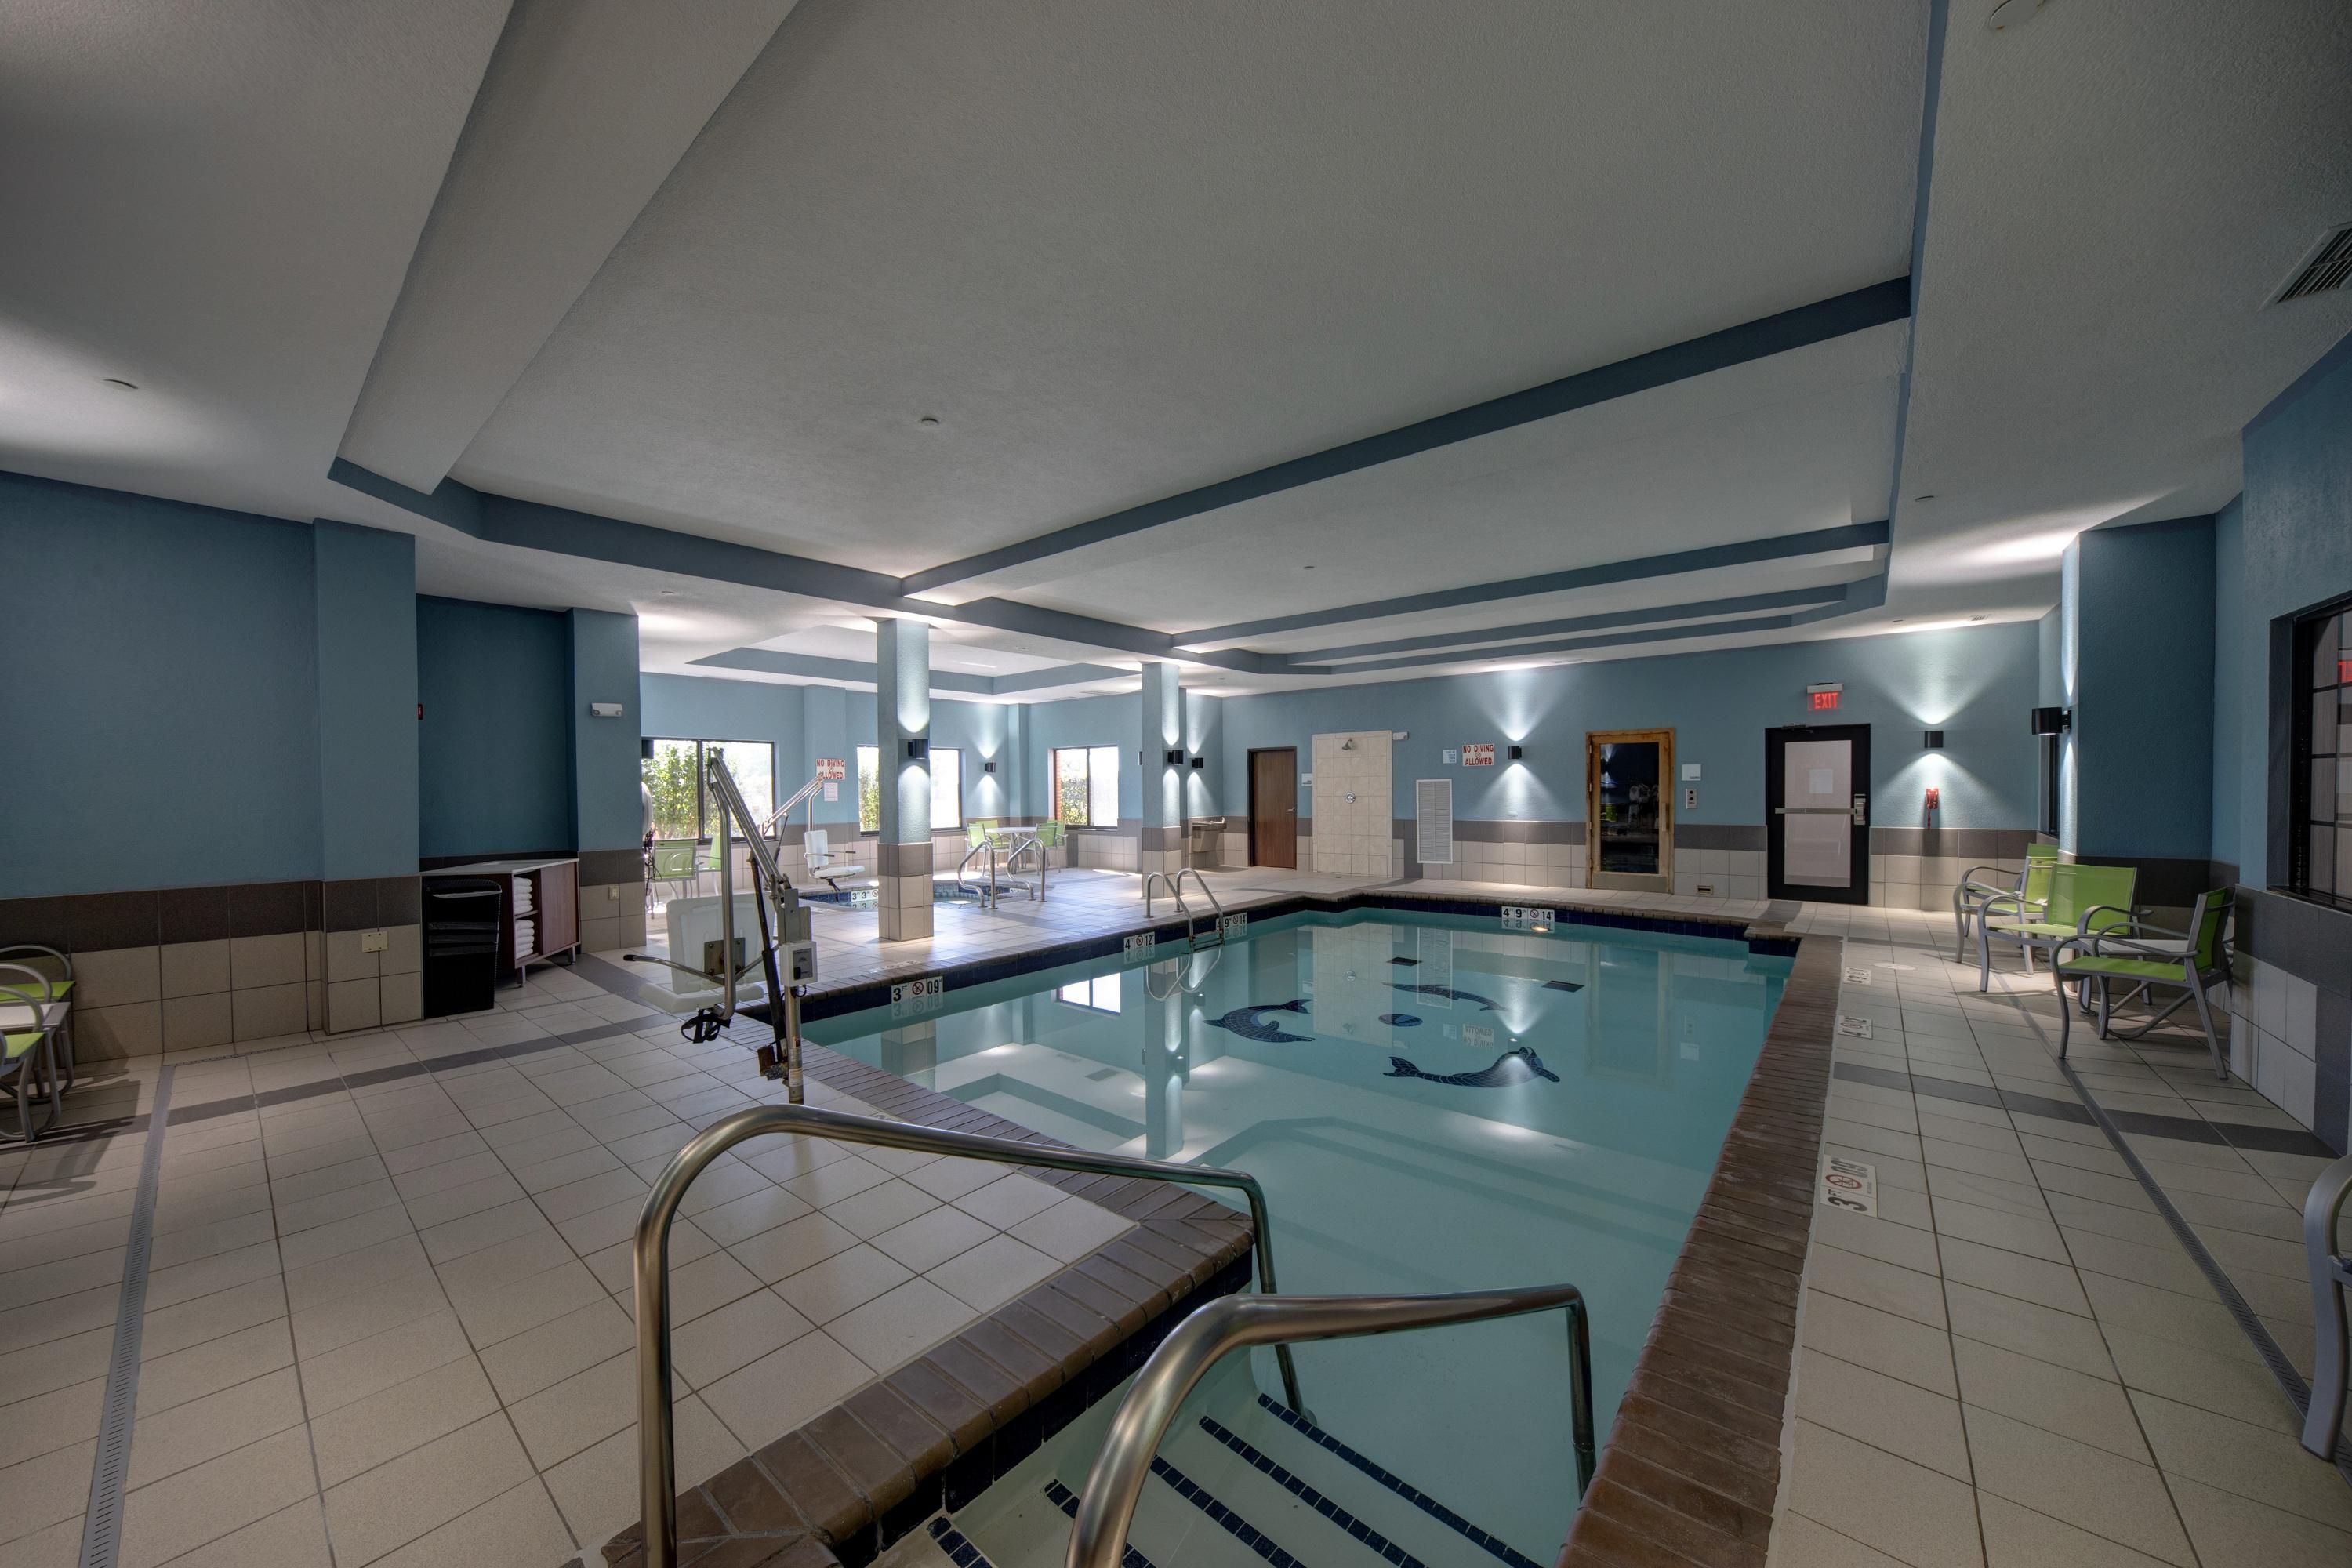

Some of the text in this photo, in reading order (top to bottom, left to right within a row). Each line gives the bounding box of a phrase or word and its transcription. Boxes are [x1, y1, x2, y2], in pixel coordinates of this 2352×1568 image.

[1814, 692, 1838, 709] EXIT
[1503, 908, 1510, 917] 4
[1515, 909, 1523, 918] 9
[1542, 911, 1552, 921] 14
[1225, 918, 1229, 928] 9
[1125, 938, 1131, 950] 4
[1145, 934, 1152, 946] 12
[893, 987, 902, 1002] 3
[1828, 1196, 1867, 1212] 3
